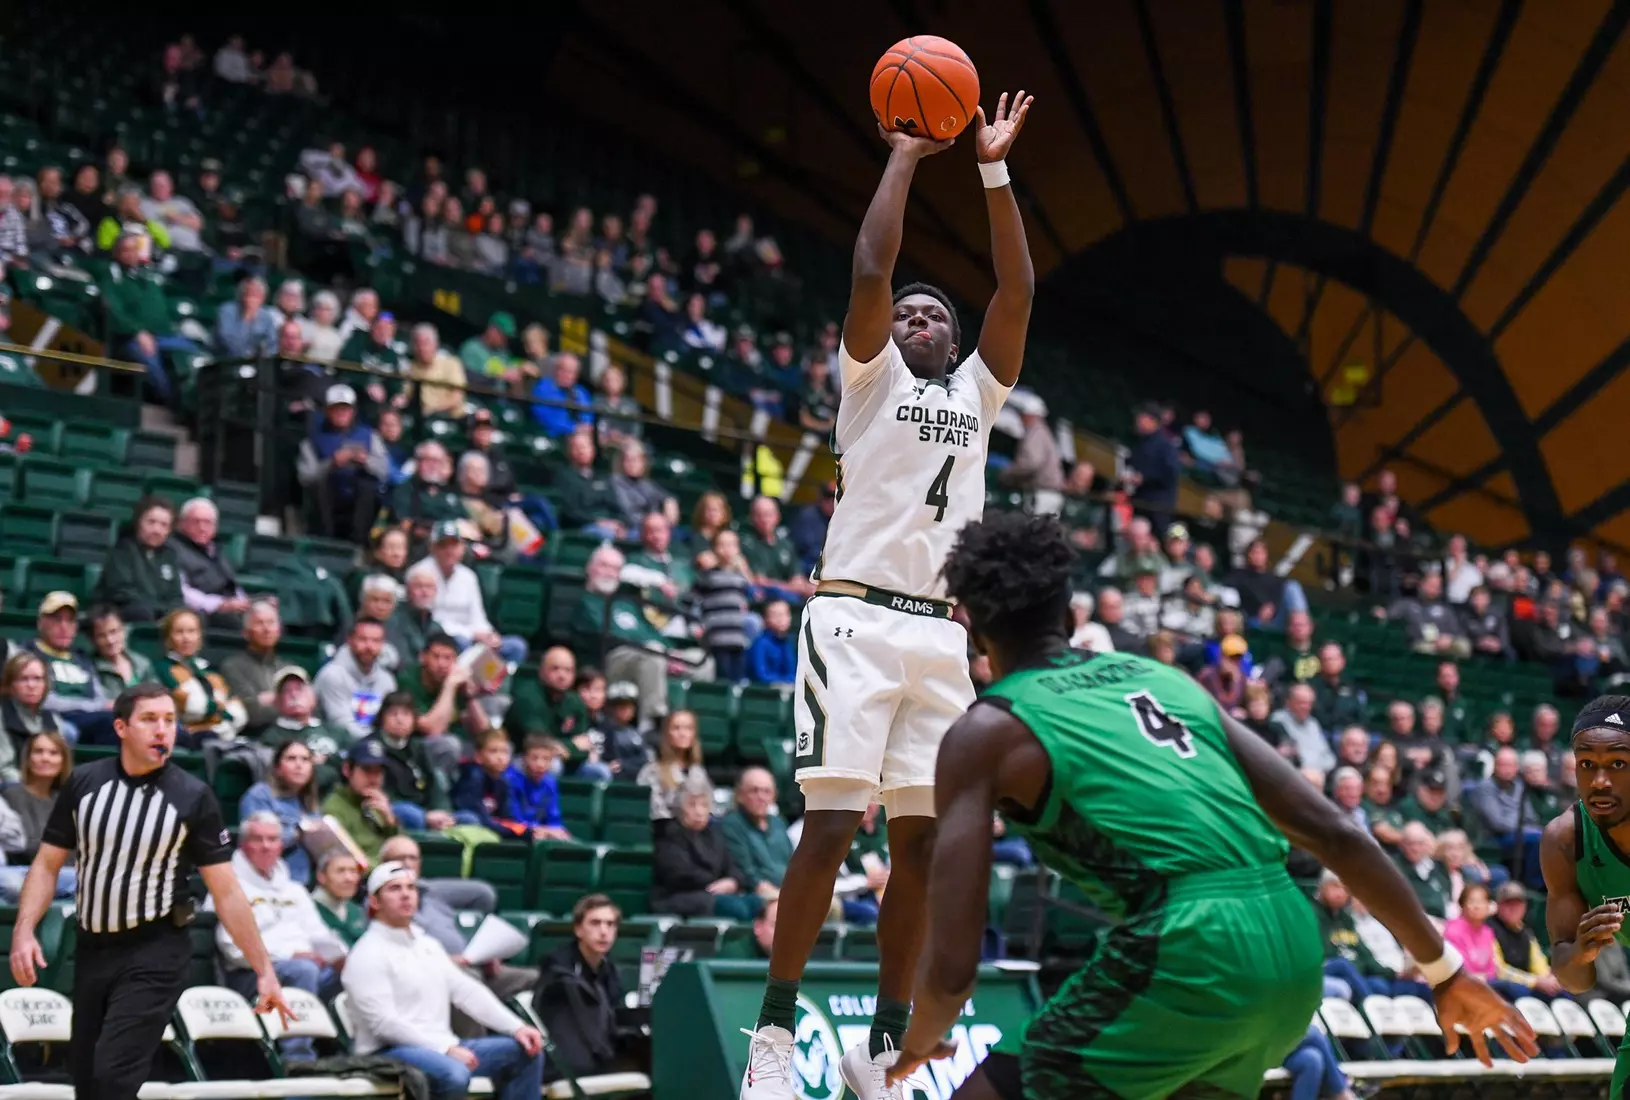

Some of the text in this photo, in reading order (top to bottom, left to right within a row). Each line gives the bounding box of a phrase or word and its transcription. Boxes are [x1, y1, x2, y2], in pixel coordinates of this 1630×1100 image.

[896, 405, 978, 432] COLORADO
[919, 425, 969, 447] STATE
[925, 454, 956, 522] 4
[891, 596, 934, 615] RAMS
[1124, 689, 1198, 759] 4
